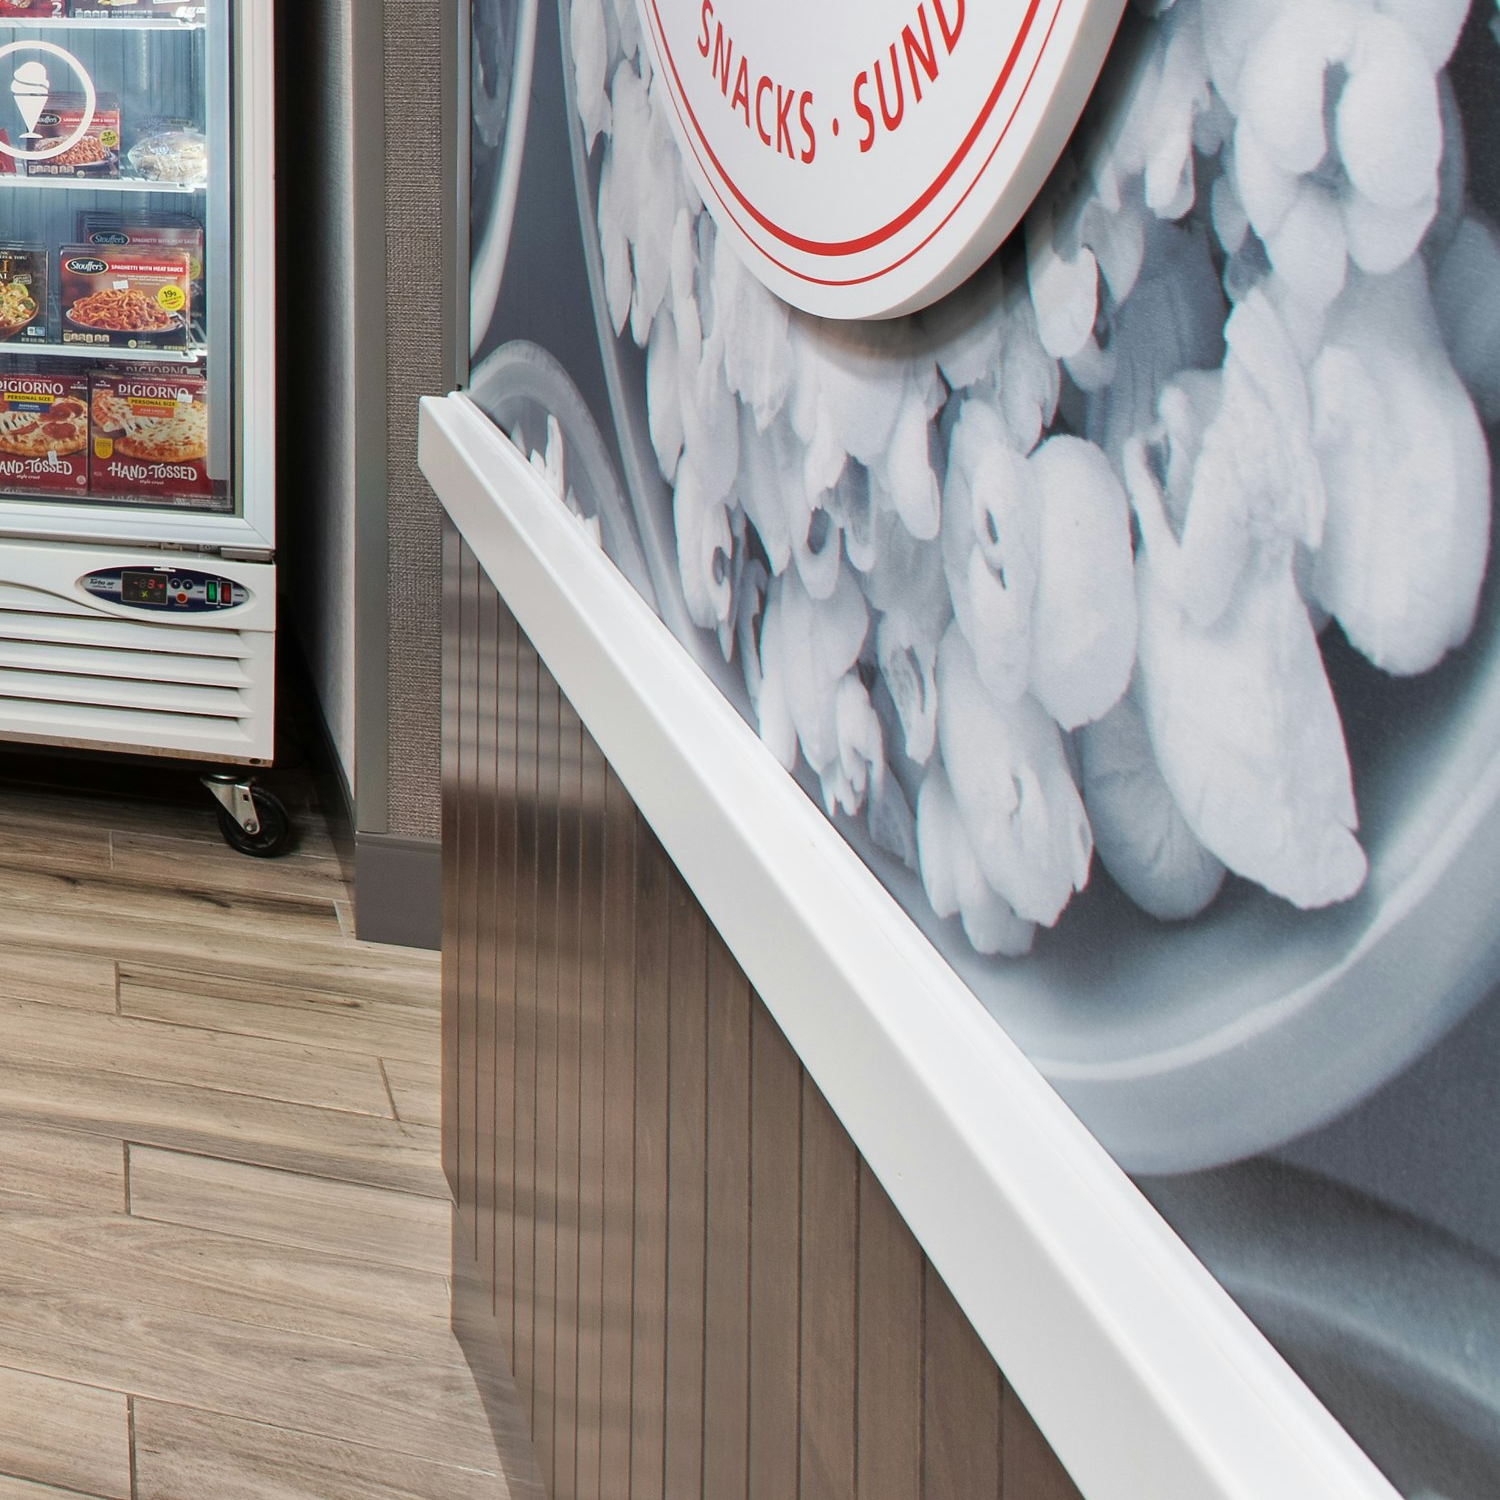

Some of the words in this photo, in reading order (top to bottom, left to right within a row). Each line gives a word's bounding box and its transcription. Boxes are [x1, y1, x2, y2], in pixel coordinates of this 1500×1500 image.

[52, 2, 62, 14] 2
[71, 260, 105, 272] Stouffer's
[7, 394, 37, 402] PERSONAL
[107, 461, 198, 482] HAND-TOSSED
